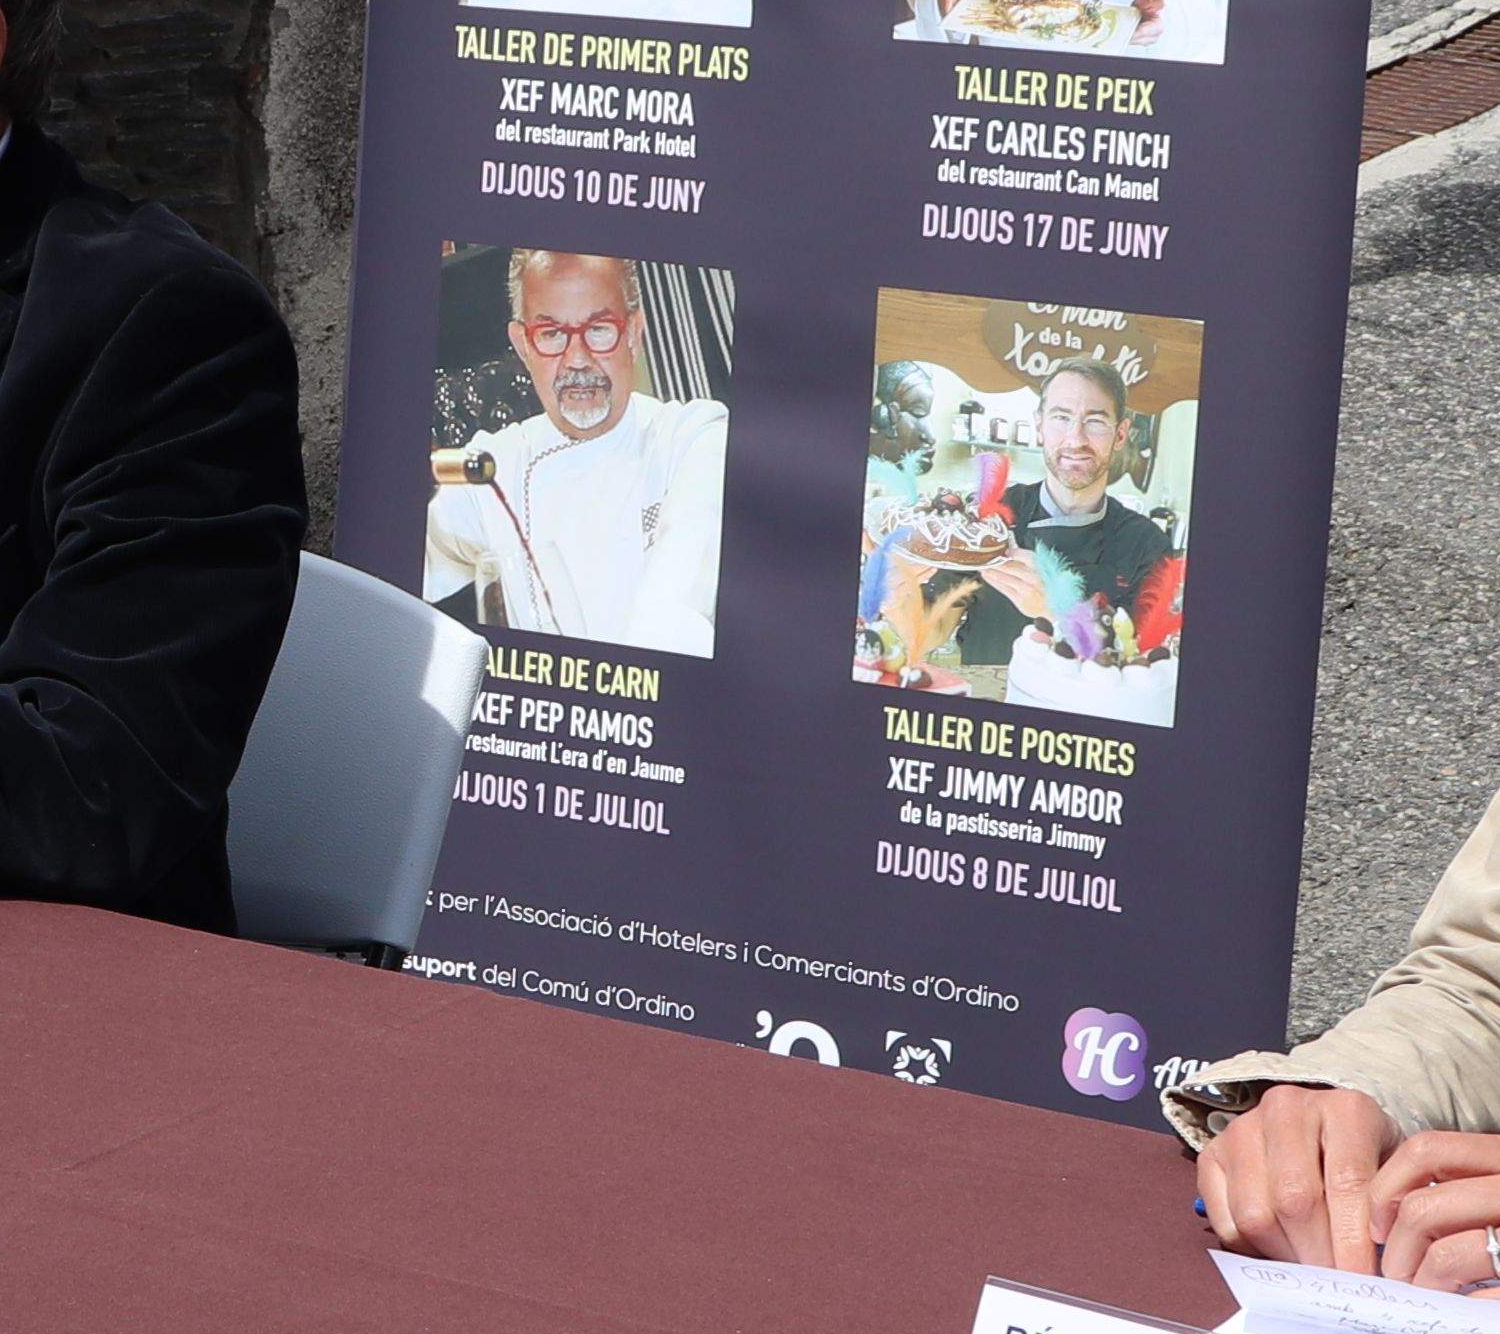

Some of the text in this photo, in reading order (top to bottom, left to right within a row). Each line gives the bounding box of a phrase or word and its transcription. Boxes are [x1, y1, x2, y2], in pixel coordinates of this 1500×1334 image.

[455, 25, 749, 82] TALLER DE PRIMER PLATS
[500, 78, 694, 126] XEF MARC MORA
[955, 65, 1155, 116] TALLER DE PEIX
[495, 119, 696, 159] del restaurant Park Hotel
[930, 114, 1170, 169] XEF CARLES FINCH
[481, 161, 705, 214] DIJOUS 10 DE JUNY
[937, 159, 1159, 202] del restaurant Can Manel
[922, 203, 1169, 260] DIJOUS 17 DE JUNY
[1039, 327, 1082, 350] de la
[560, 655, 587, 691] DE
[595, 661, 660, 702] CARN
[472, 692, 653, 748] XEF PEP RAMOS
[884, 706, 1135, 776] TALLER DE POSTRES
[550, 742, 588, 769] L'era
[592, 749, 626, 775] d'en
[630, 756, 685, 784] Jaume
[535, 783, 545, 814] 1
[554, 786, 585, 820] DE
[588, 792, 671, 835] JULIOL
[887, 757, 1123, 825] XEF JIMMY AMBOR
[900, 800, 1106, 859] de la pastisseria Jimmy
[876, 841, 1122, 913] DIJOUS 8 DE JULIOL
[439, 889, 1020, 1014] per l'Associació d'Hotelers i Comerciants d'Ordino
[401, 953, 695, 1026] suport del Comú d'Ordino
